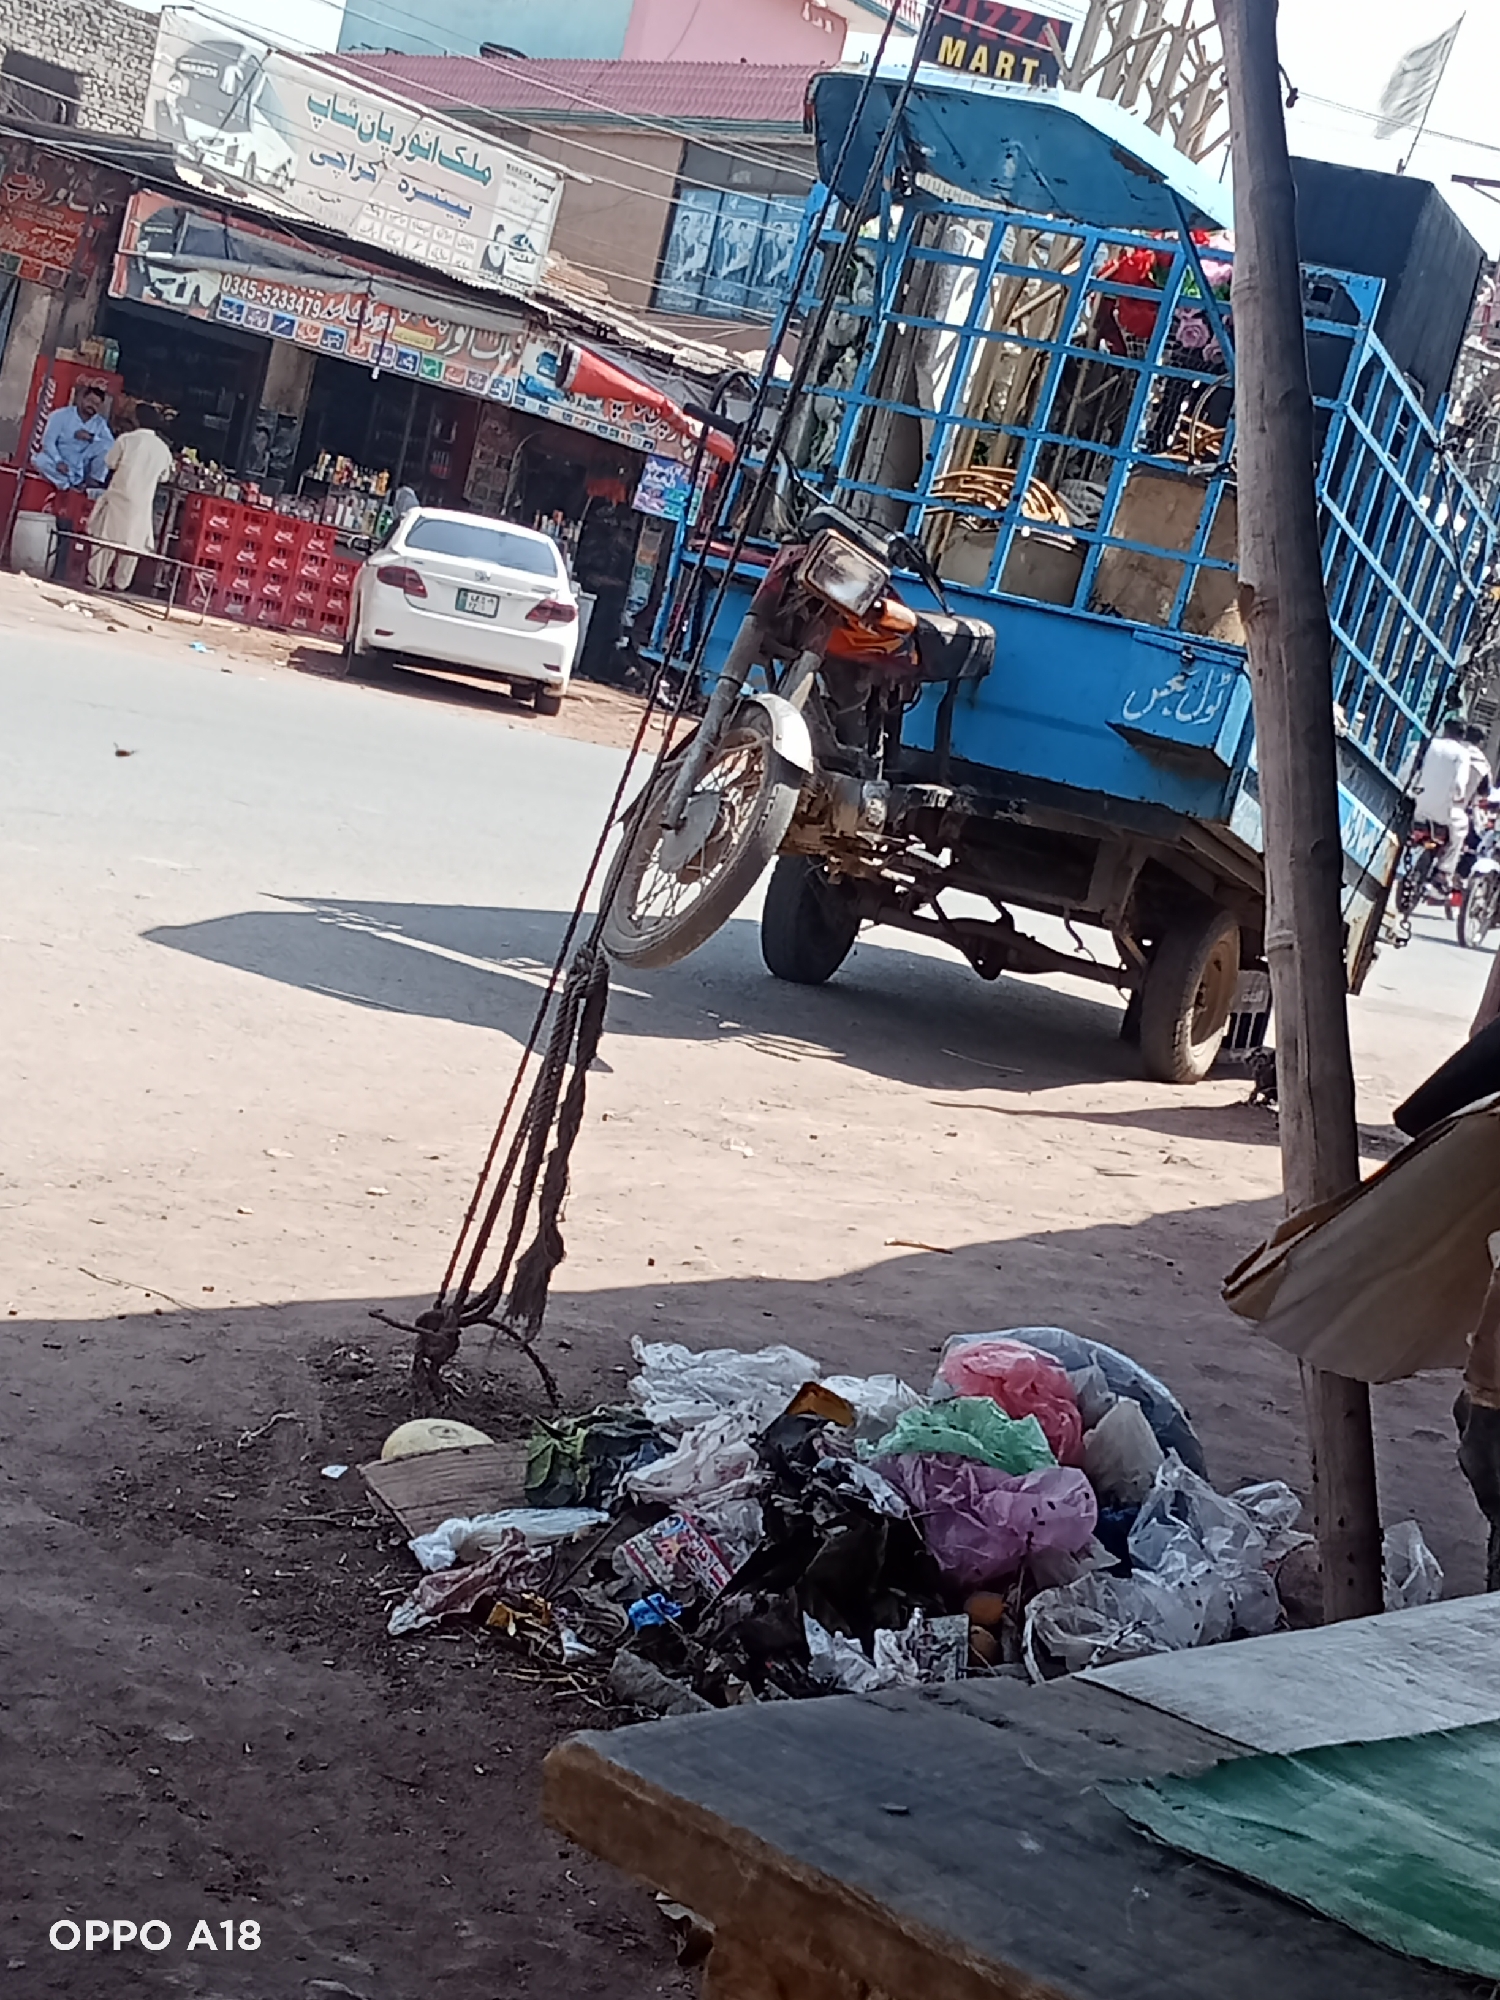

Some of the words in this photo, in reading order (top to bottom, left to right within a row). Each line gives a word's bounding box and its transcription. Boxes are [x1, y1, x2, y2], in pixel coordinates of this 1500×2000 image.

[938, 36, 1040, 84] MART
[307, 92, 359, 131] شاپ
[358, 110, 395, 157] پان
[393, 127, 440, 163] انور
[310, 147, 381, 184] کراچی
[438, 145, 493, 186] ملک
[223, 274, 320, 317] 0345-5233479
